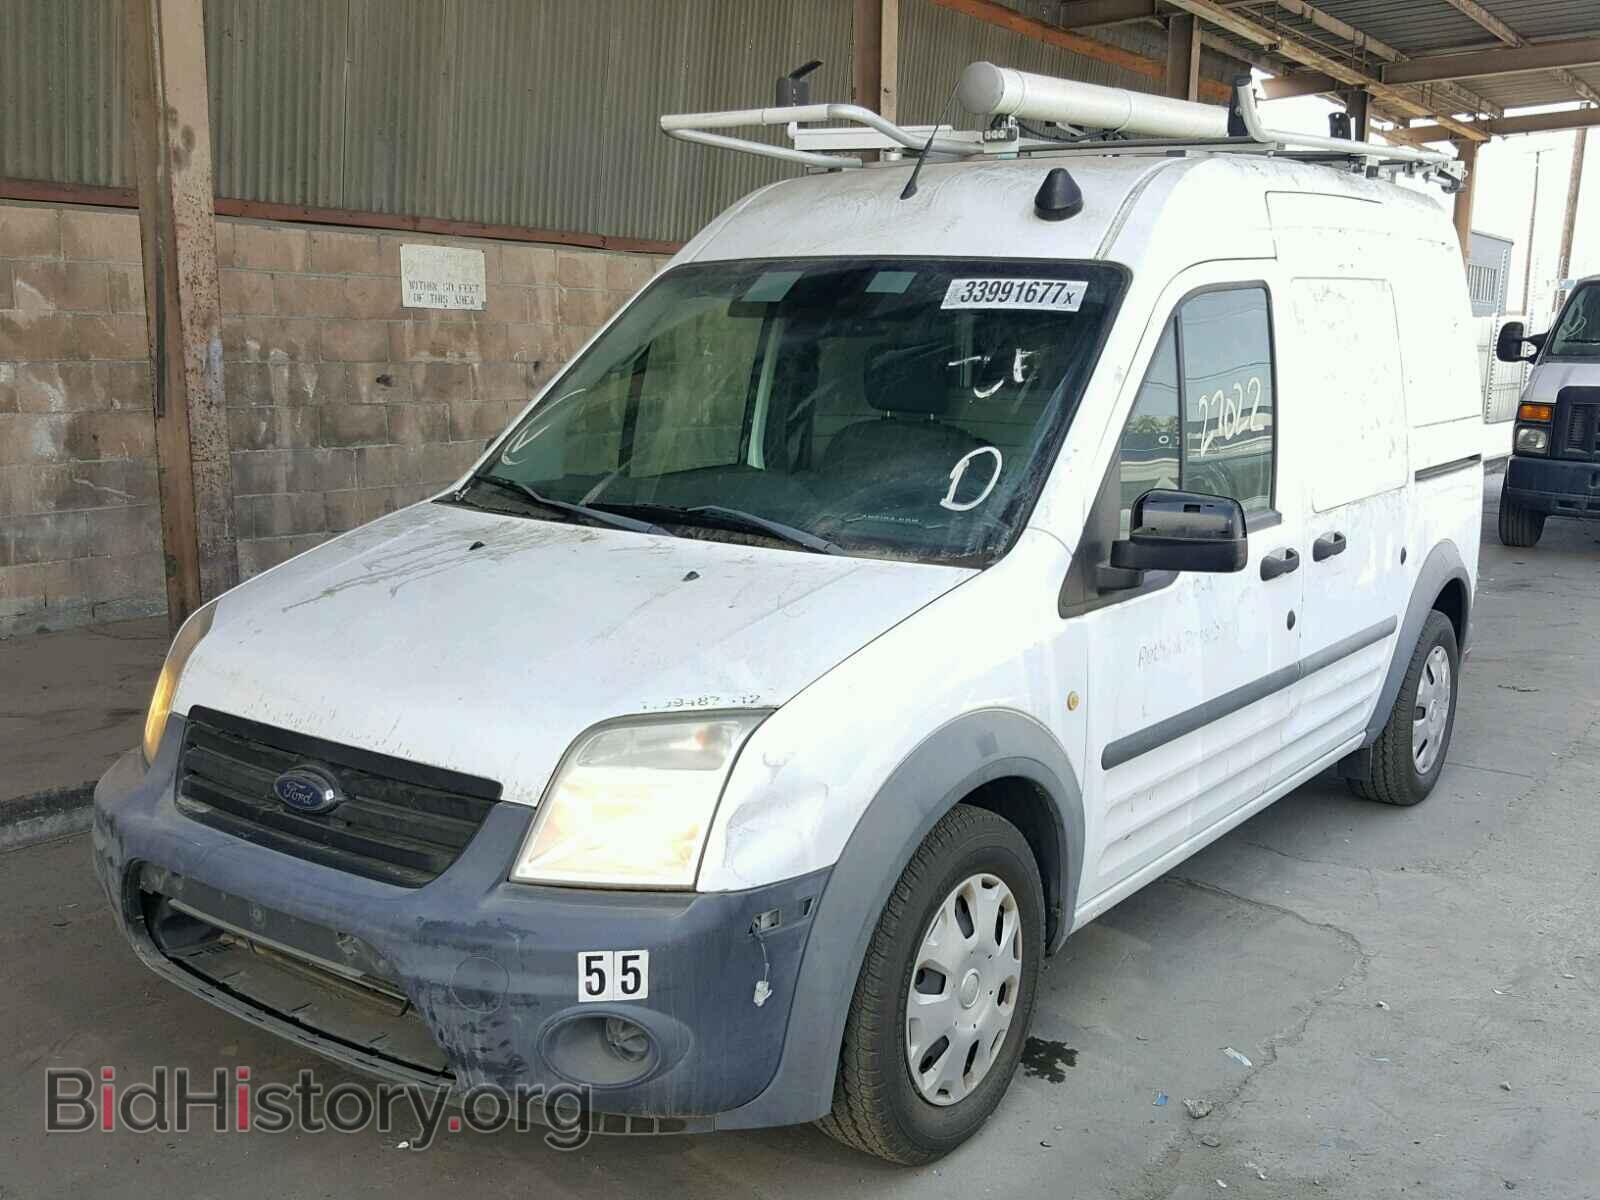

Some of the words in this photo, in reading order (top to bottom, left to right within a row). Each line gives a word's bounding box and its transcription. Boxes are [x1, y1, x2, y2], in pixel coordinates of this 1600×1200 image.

[408, 279, 438, 291] WITHIN
[458, 283, 480, 294] FEET
[430, 293, 449, 304] THIS
[283, 781, 314, 805] Ford
